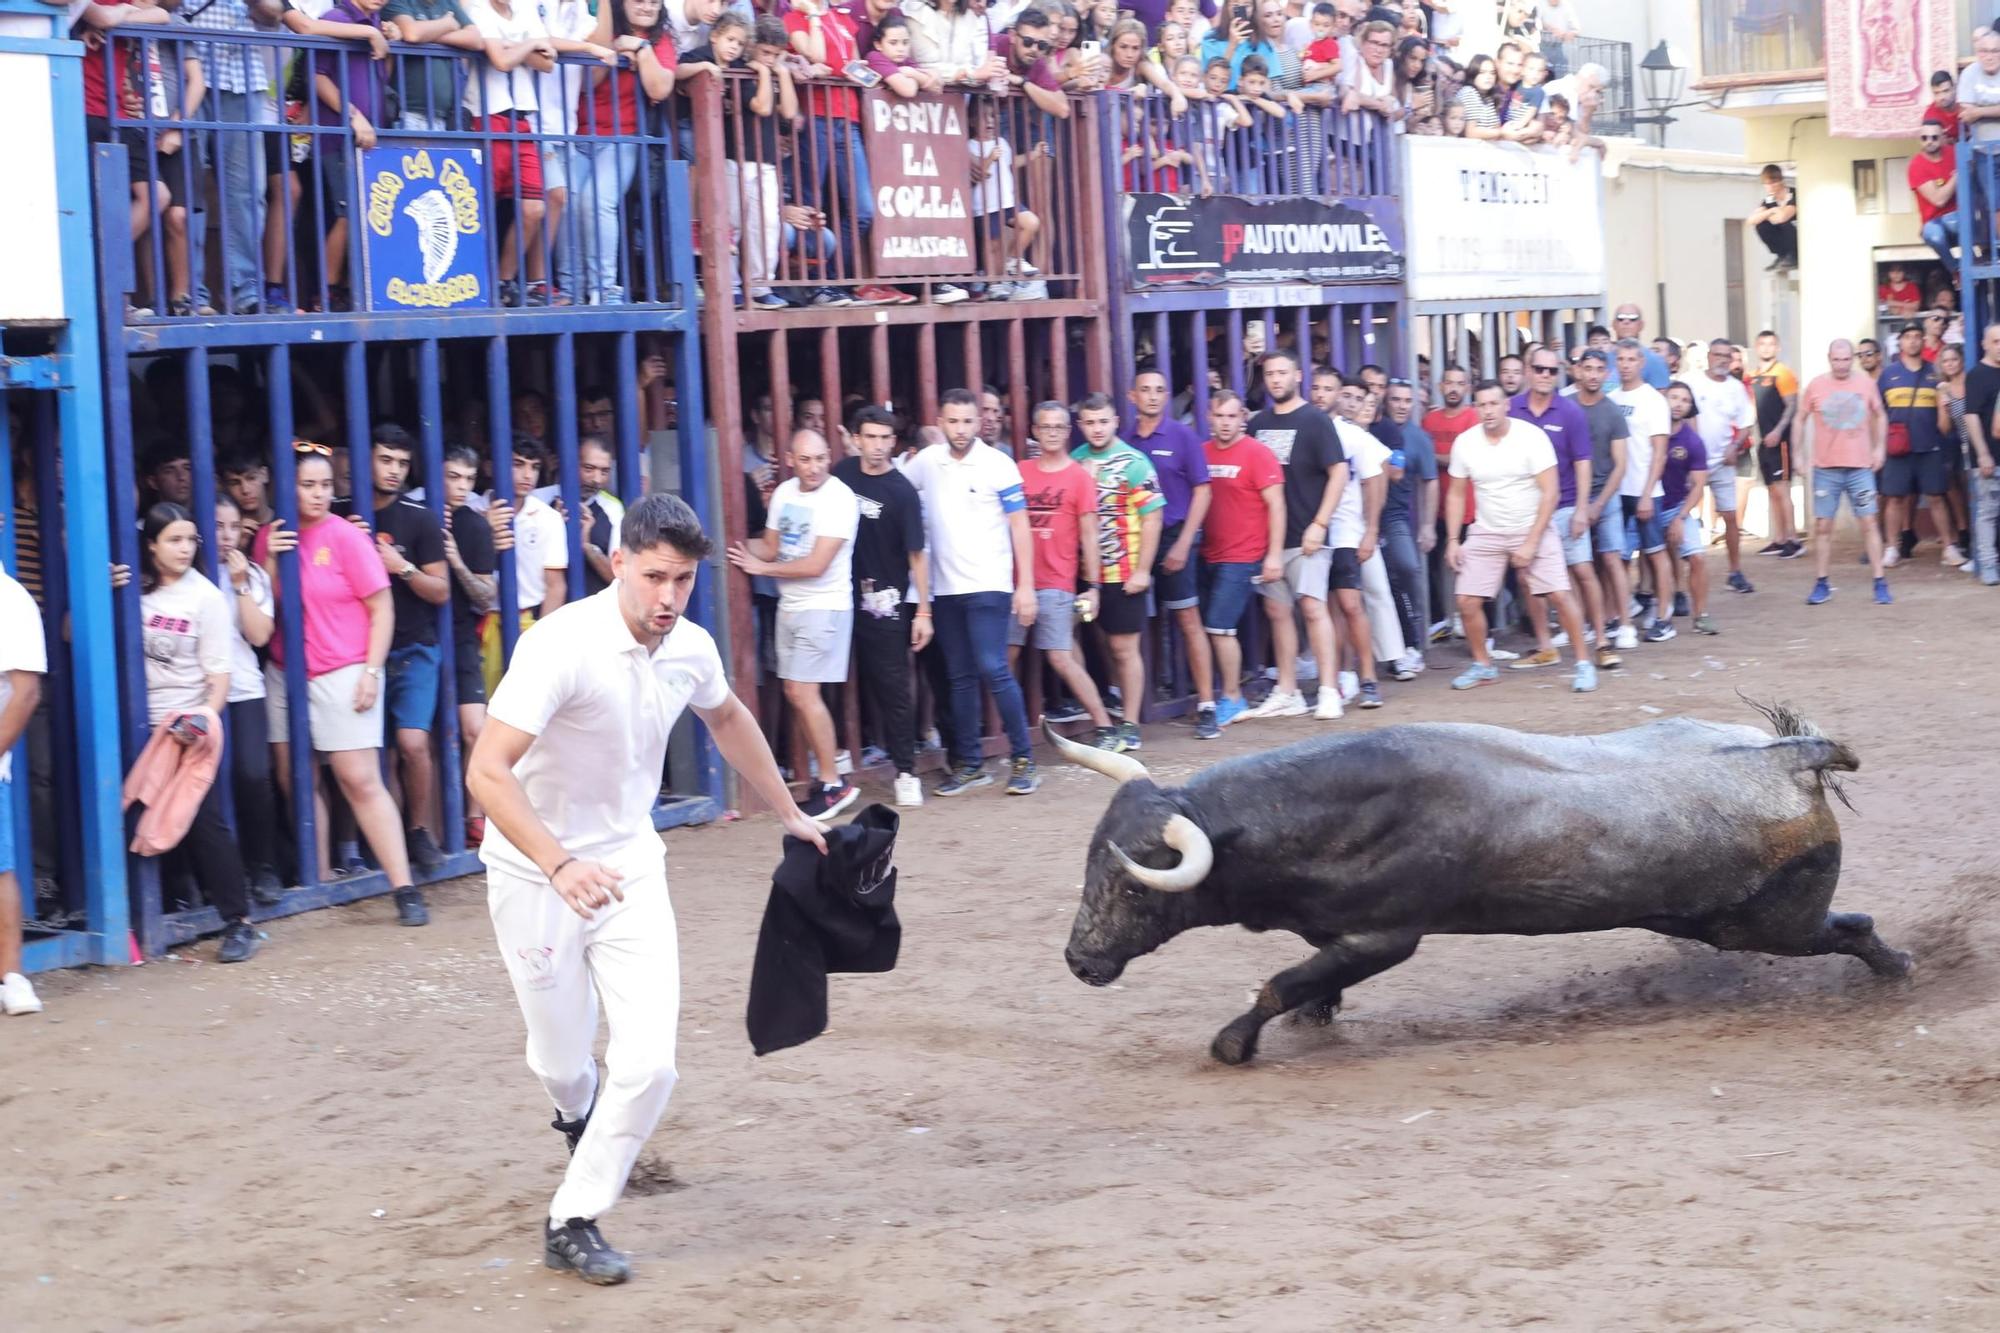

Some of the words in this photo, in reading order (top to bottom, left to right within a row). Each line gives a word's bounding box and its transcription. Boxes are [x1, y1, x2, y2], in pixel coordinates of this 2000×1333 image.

[402, 150, 435, 181] LA
[902, 143, 939, 177] LA
[877, 186, 967, 219] COLLA
[882, 236, 968, 258] ALMASSORA
